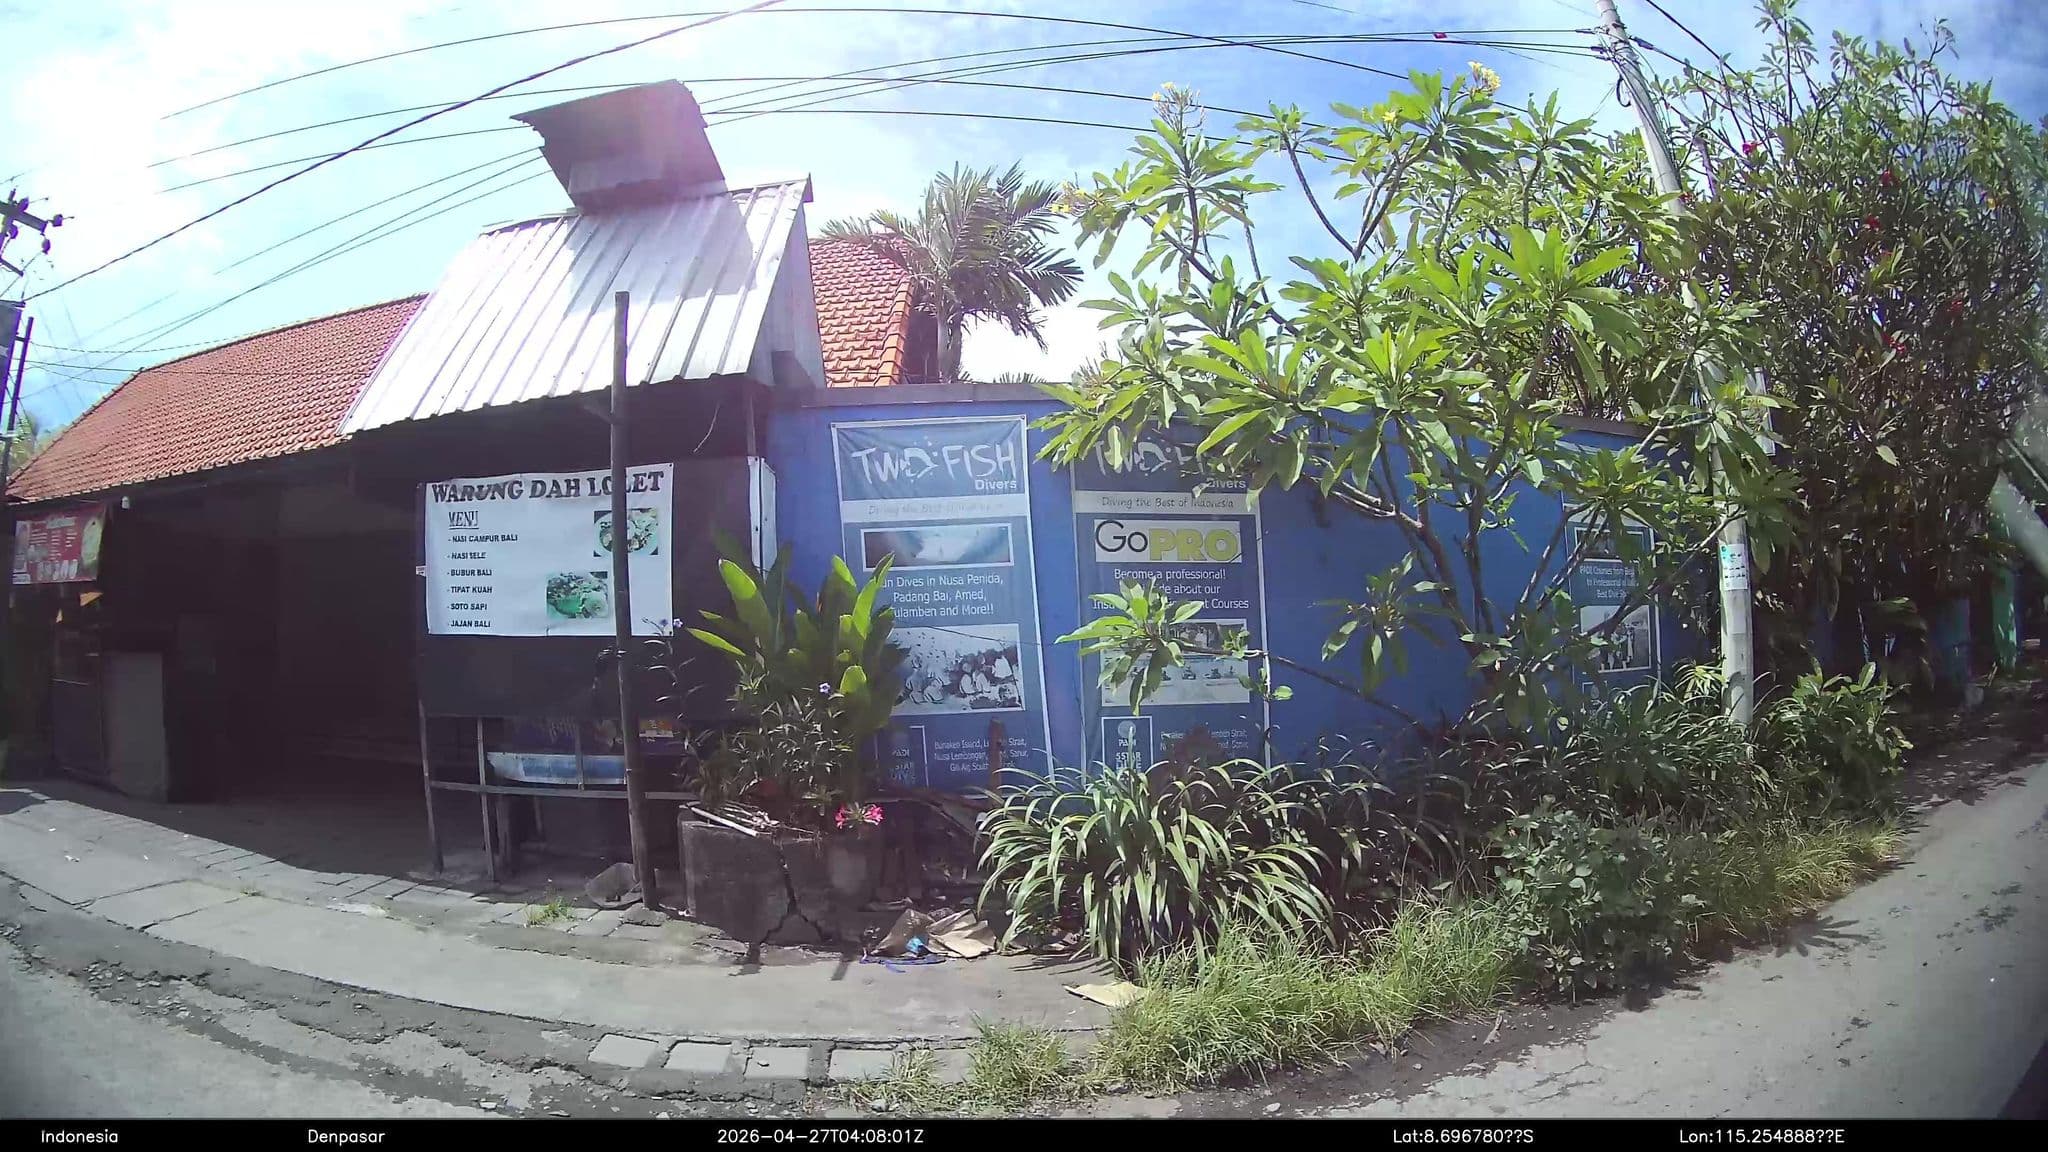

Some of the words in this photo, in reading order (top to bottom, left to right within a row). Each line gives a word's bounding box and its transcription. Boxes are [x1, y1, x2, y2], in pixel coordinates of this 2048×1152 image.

[851, 447, 939, 485] TWO
[941, 440, 1017, 480] FISH
[974, 478, 1018, 490] Divers
[1206, 477, 1247, 488] Divers
[432, 480, 524, 502] WARUNG
[528, 478, 580, 499] DAH
[1101, 496, 1133, 509] Diving
[1136, 497, 1150, 507] the
[1155, 497, 1174, 507] Best
[1178, 498, 1188, 507] of
[1191, 498, 1235, 508] Indonesia
[452, 535, 467, 543] NASI
[468, 535, 499, 543] CAMPUR
[501, 534, 518, 542] BALI
[1095, 519, 1239, 561] GoPRO
[451, 552, 468, 560] NASI
[450, 569, 475, 577] BUBUR
[1114, 568, 1154, 580] Become
[1156, 571, 1163, 580] a
[1165, 569, 1226, 582] professional!
[896, 576, 924, 587] Dives
[926, 576, 936, 587] in
[939, 575, 964, 586] Nusa
[966, 573, 1004, 585] Penida,
[450, 586, 471, 594] TIPAT
[472, 586, 493, 594] KUAH
[1173, 583, 1202, 594] about
[1204, 585, 1221, 594] our
[893, 591, 930, 604] Padang
[933, 590, 952, 602] Bai,
[954, 589, 987, 601] Amed,
[470, 603, 488, 611] SAPI
[1210, 598, 1249, 609] Courses
[891, 606, 937, 618] ulamben
[939, 605, 959, 616] and
[961, 603, 994, 616] More!!
[474, 620, 491, 628] BALI
[1118, 739, 1137, 747] PAI
